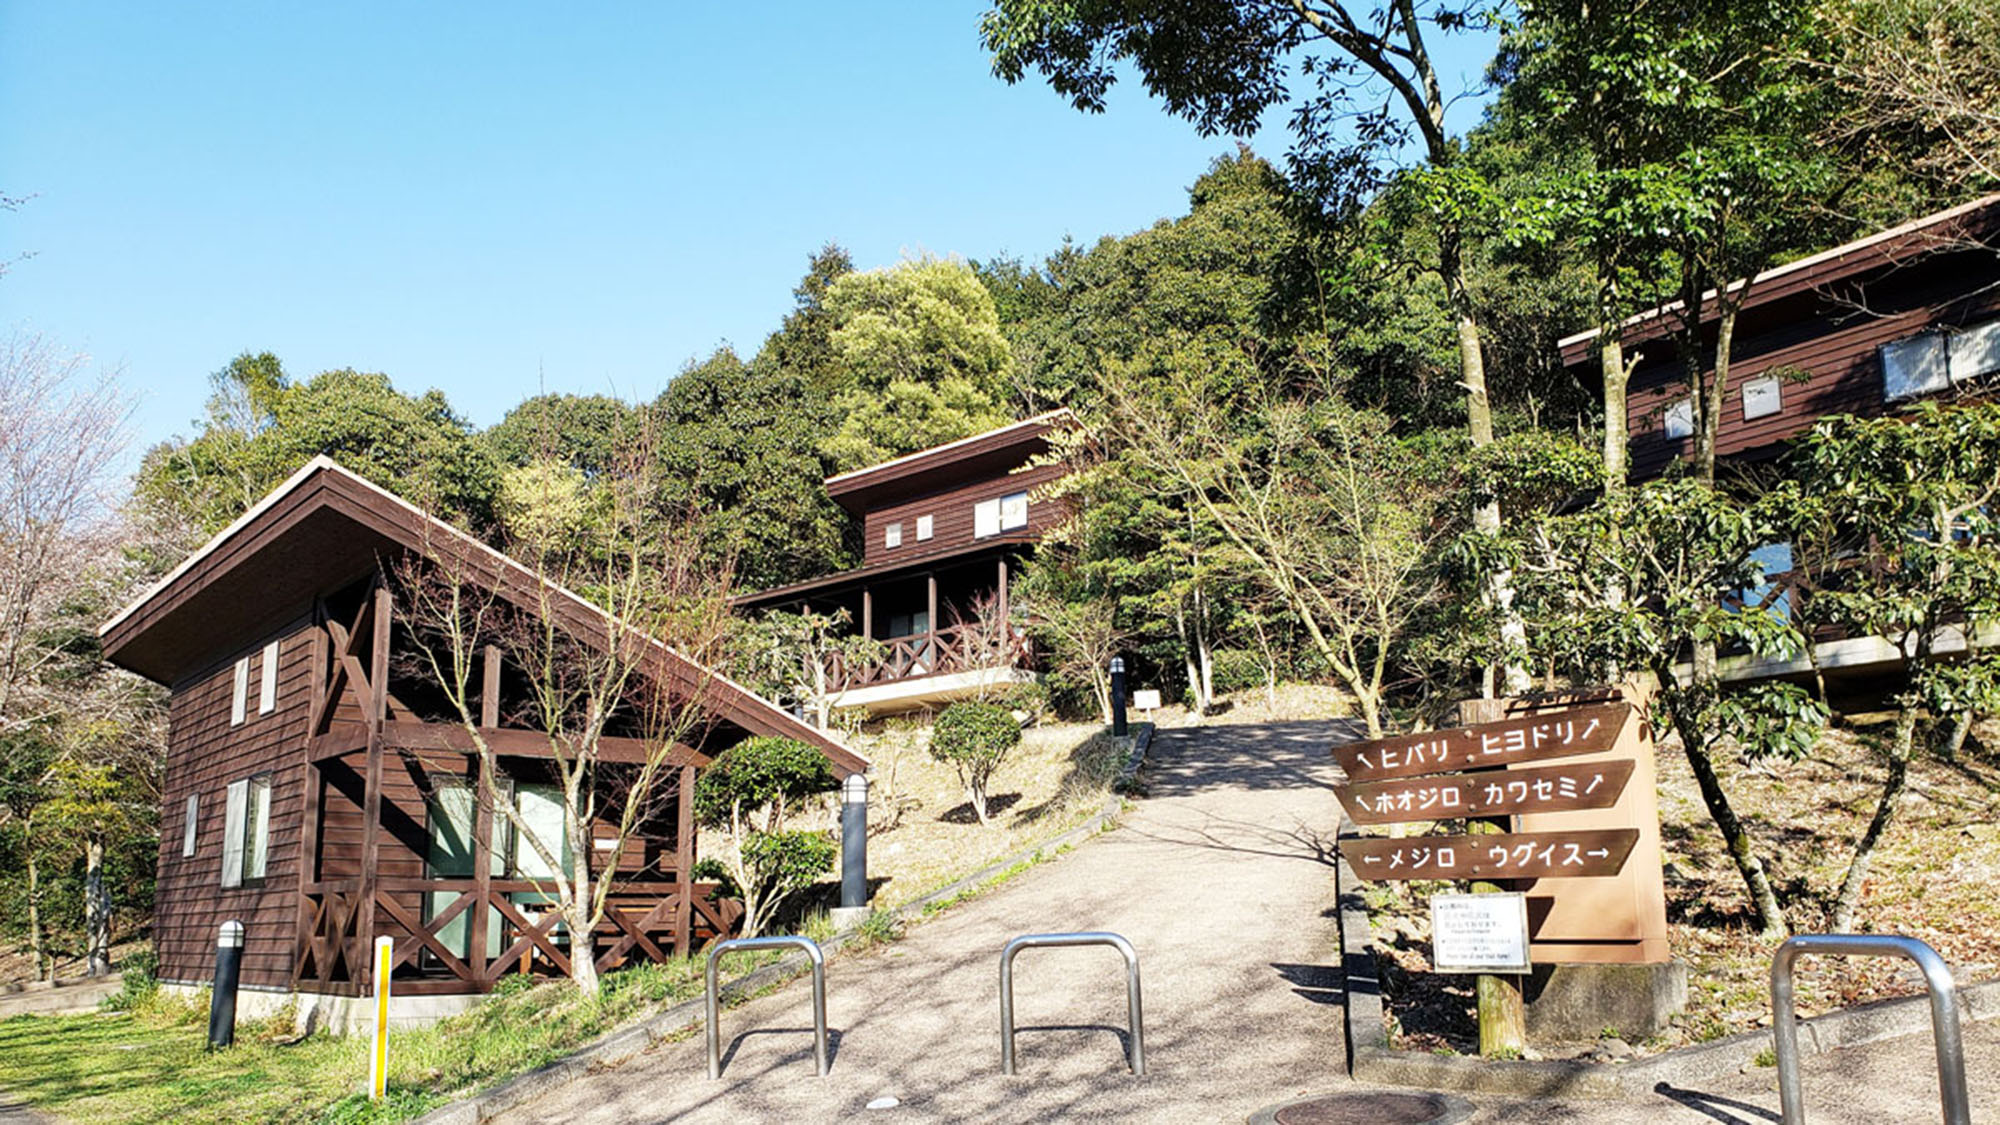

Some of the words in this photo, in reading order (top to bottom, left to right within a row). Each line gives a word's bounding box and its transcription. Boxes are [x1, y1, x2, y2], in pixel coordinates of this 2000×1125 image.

[1381, 739, 1449, 769] ヒバリ
[1482, 720, 1574, 755] ヒヨドリ
[1375, 785, 1460, 814] ホオジロ
[1484, 776, 1578, 806] カワセミ
[1388, 847, 1455, 869] メジロ
[1489, 841, 1585, 868] ウグイス
